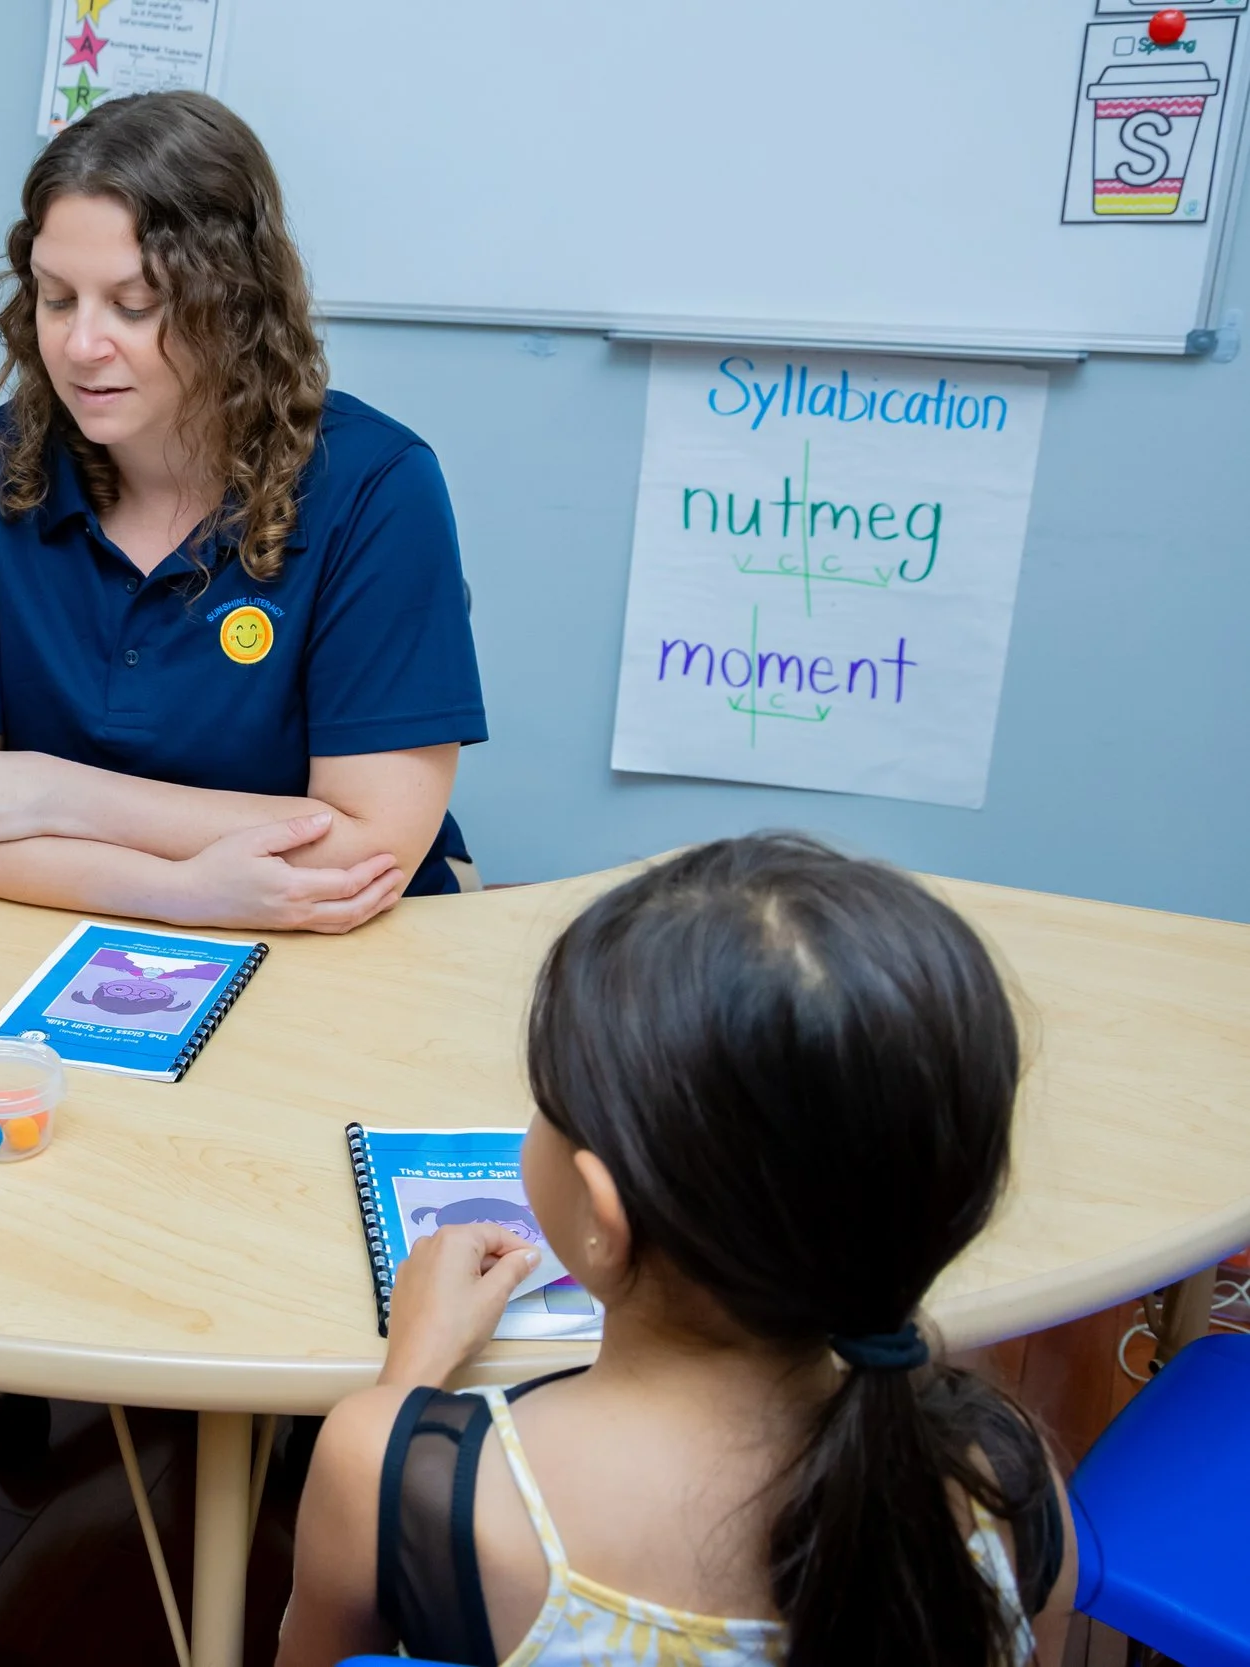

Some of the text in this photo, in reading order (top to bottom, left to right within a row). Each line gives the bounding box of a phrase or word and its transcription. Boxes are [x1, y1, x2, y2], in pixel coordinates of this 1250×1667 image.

[79, 36, 93, 55] A
[76, 86, 90, 105] R
[1115, 109, 1172, 187] S
[708, 355, 1008, 432] Syllabication
[682, 476, 942, 583] nutmeg
[206, 597, 286, 622] SUNSHINE LITERACY
[657, 637, 918, 703] moment
[45, 1018, 68, 1028] Milk
[70, 1022, 95, 1032] Spilt
[115, 1029, 144, 1038] Glass
[148, 1033, 168, 1041] The
[399, 1167, 518, 1179] The Glass of Spilt
